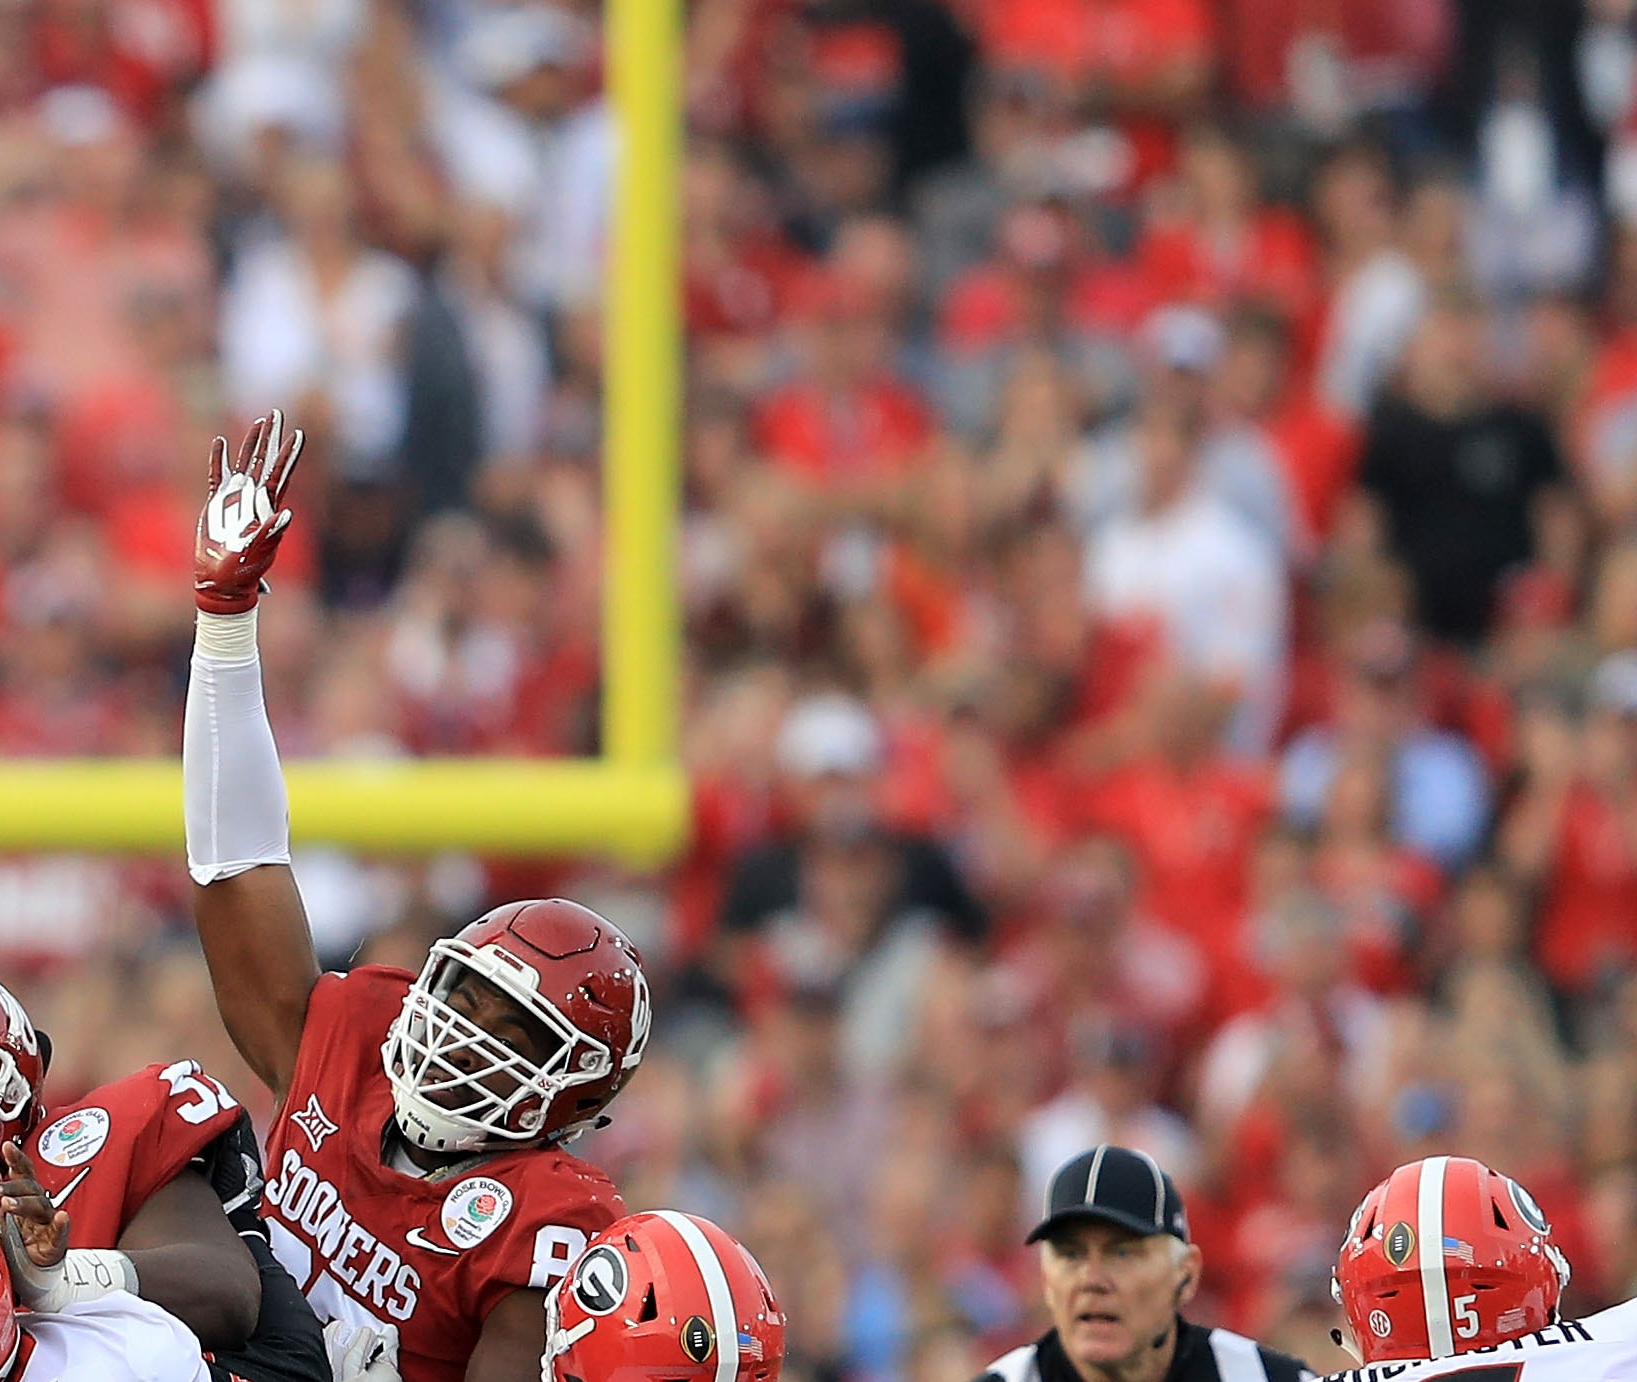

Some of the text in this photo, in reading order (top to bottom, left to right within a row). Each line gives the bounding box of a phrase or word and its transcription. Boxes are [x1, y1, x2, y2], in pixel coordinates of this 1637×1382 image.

[479, 1180, 506, 1201] BOWL
[264, 1148, 422, 1322] SOONERS
[1453, 1293, 1480, 1339] 5
